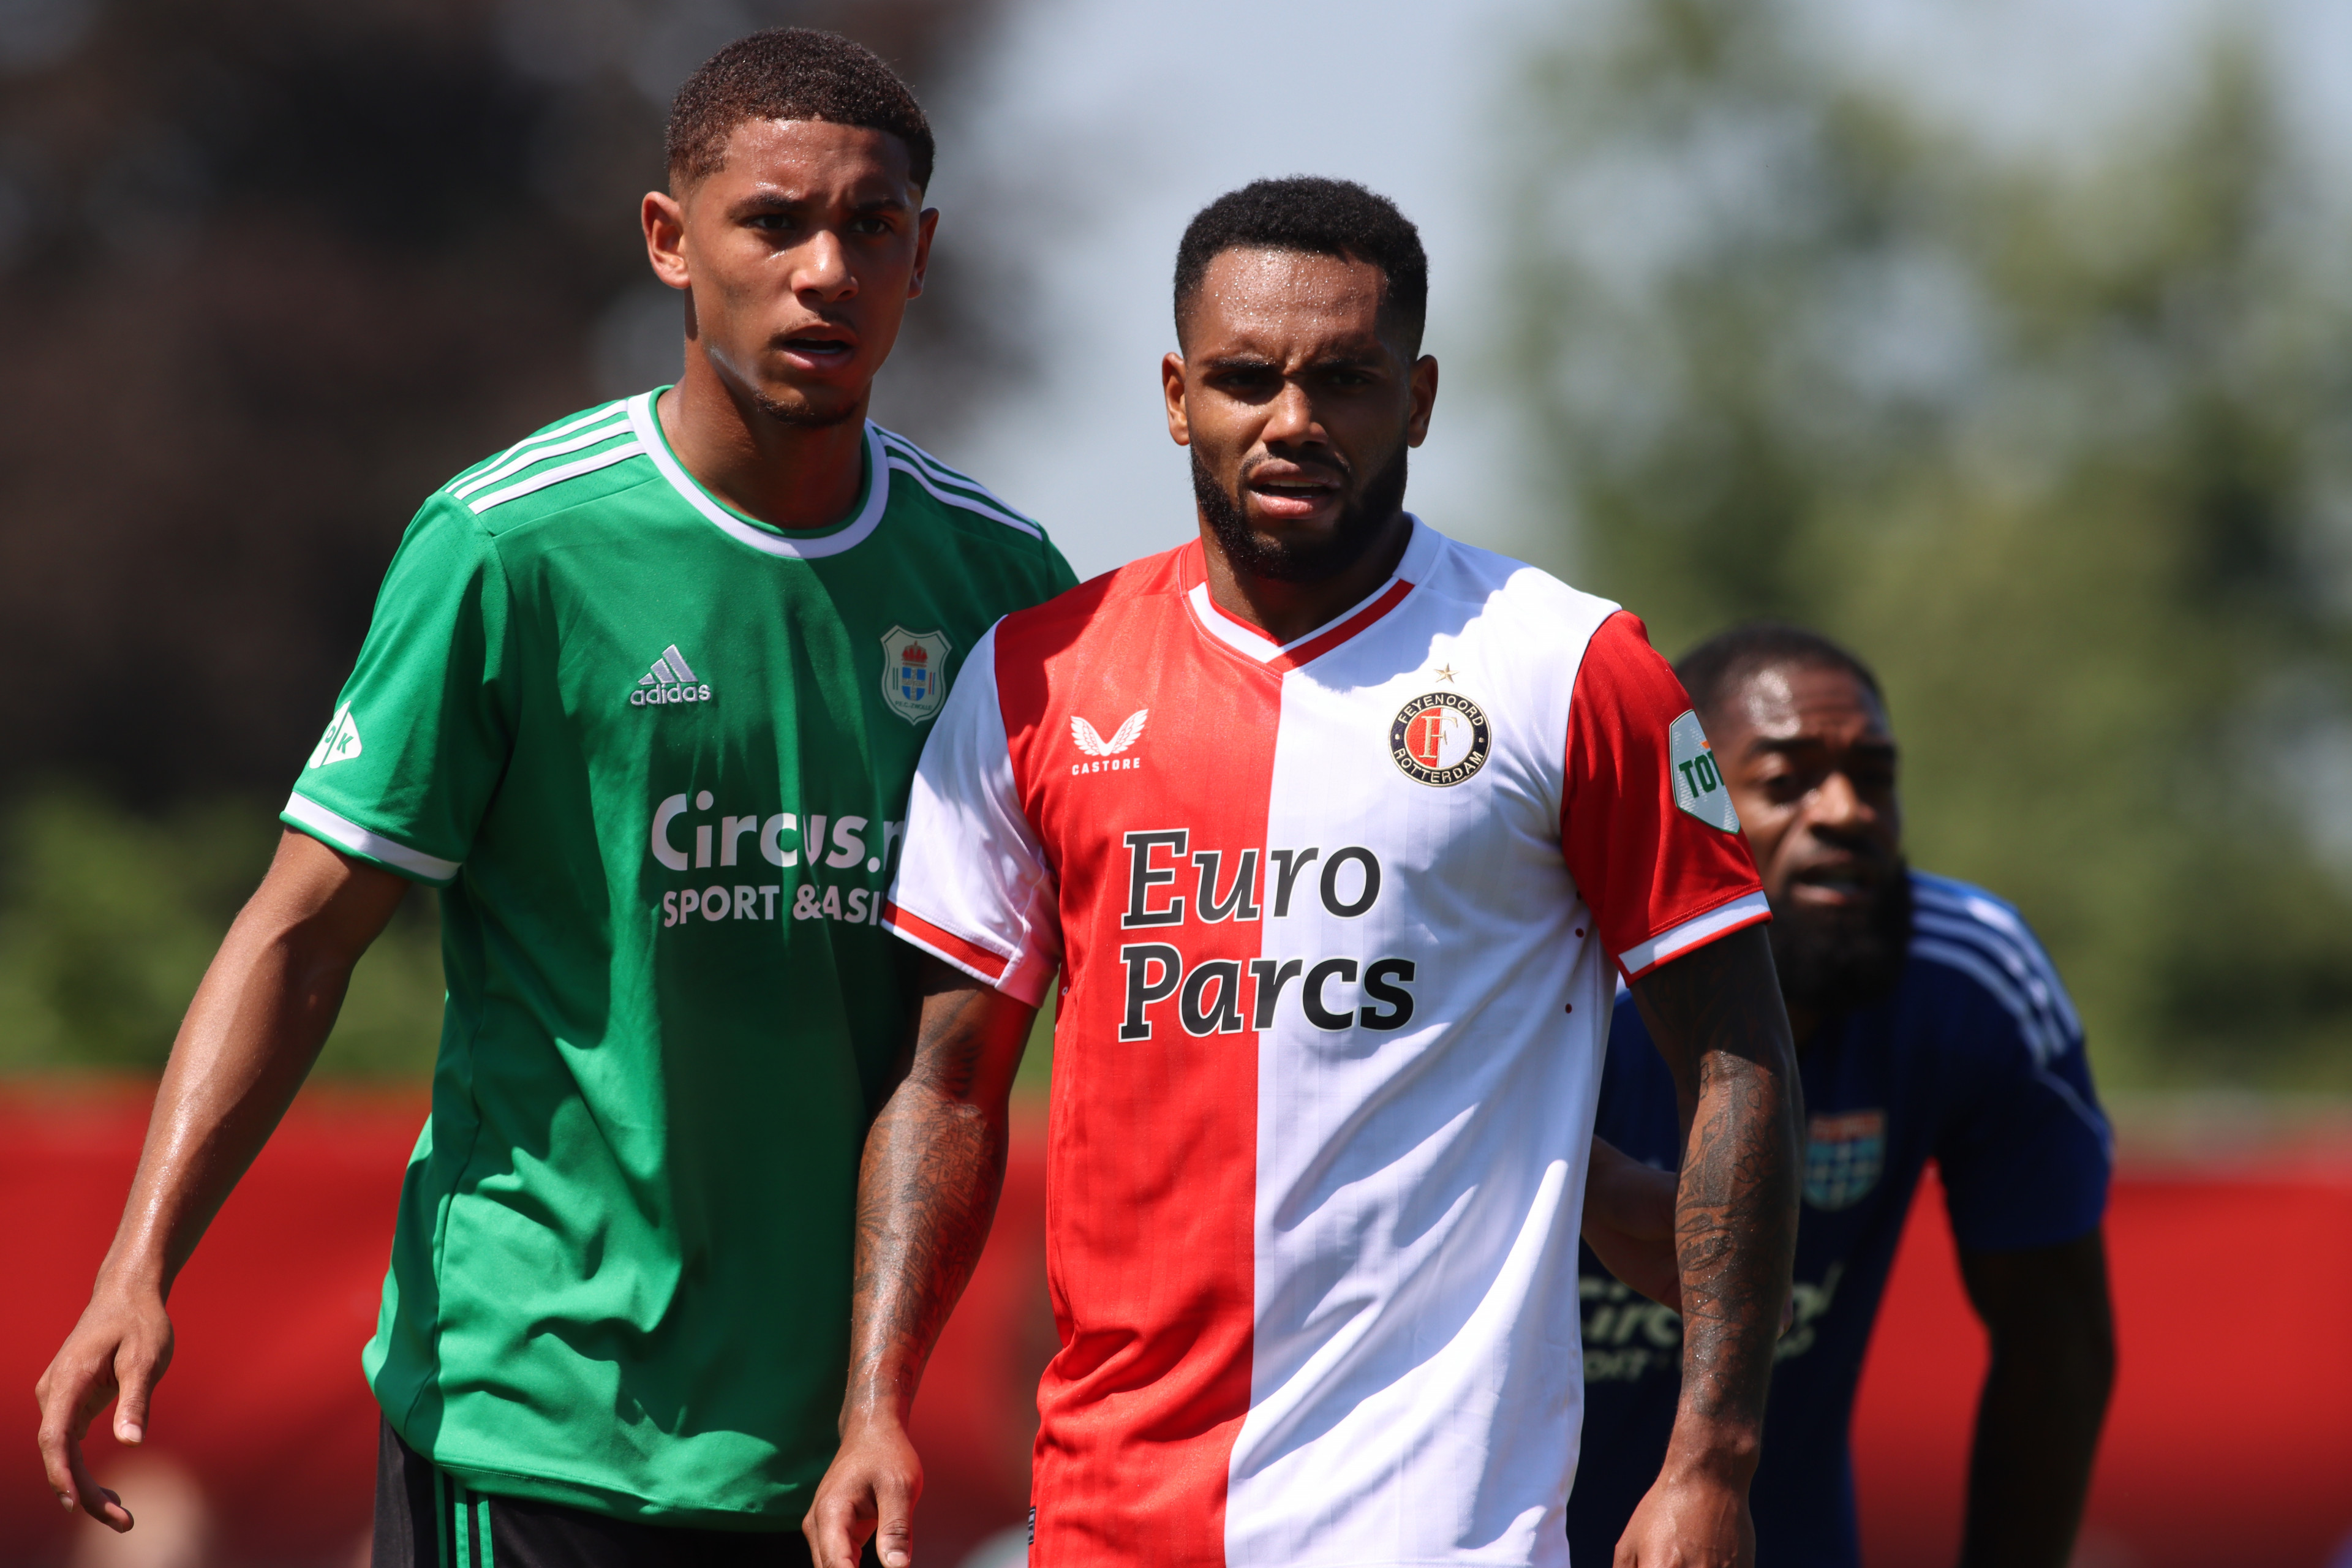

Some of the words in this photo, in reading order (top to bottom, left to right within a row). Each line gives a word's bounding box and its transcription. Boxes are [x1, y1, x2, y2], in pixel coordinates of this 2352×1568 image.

[630, 684, 711, 707] adidas
[1397, 694, 1484, 726] FEYENOORD
[1419, 715, 1458, 759] F
[1072, 757, 1140, 775] CASTORE
[1393, 747, 1484, 783] ROTTERDAM
[1121, 828, 1382, 930] Euro
[663, 885, 780, 928] SPORT
[1118, 942, 1417, 1042] Parcs
